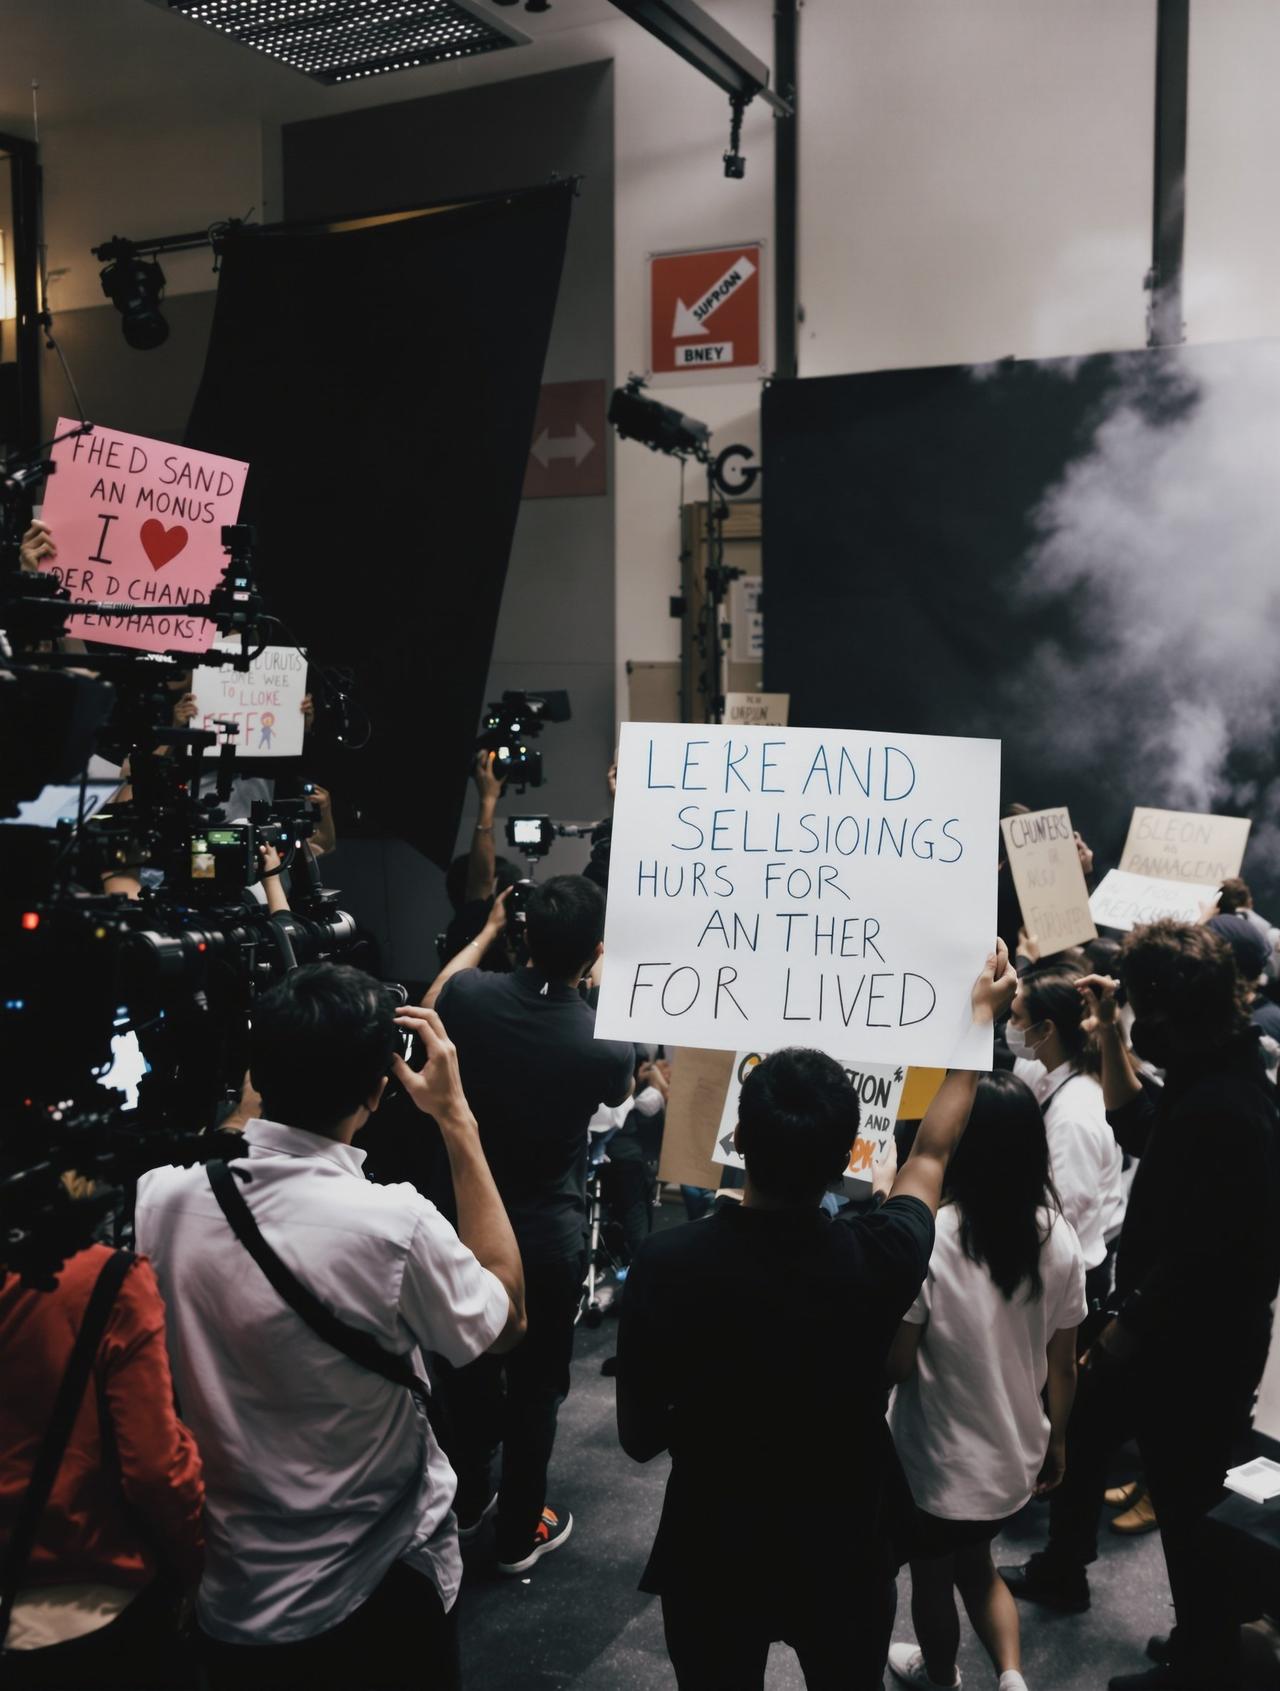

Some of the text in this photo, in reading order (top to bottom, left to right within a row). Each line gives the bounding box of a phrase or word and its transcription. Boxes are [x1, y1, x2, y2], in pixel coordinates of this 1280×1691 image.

[684, 346, 724, 362] BNEY
[159, 456, 234, 497] SAND
[90, 478, 215, 524] AN MONUS
[88, 514, 119, 564] I
[802, 744, 916, 801] AND
[638, 860, 851, 900] HURS FOR
[629, 962, 936, 1027] FOR LIVED
[864, 1113, 890, 1131] AND
